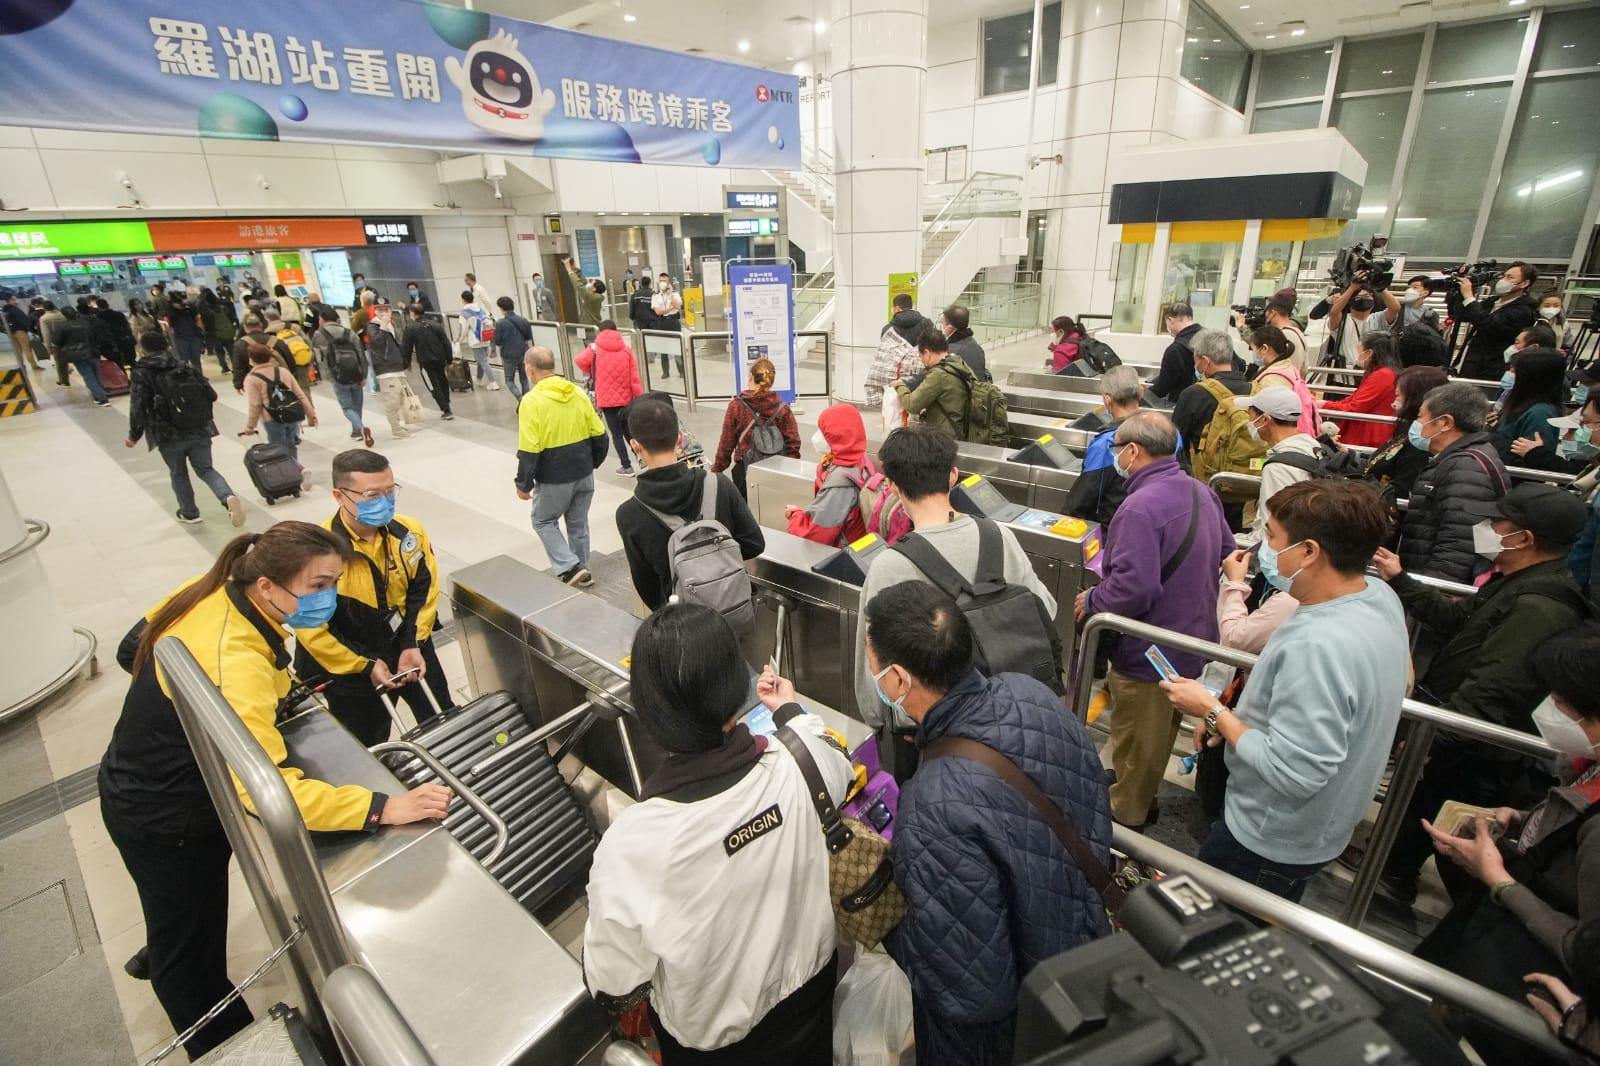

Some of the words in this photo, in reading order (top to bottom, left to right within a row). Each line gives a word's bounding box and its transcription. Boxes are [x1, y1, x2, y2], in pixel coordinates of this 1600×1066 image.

[149, 17, 442, 103] 羅湖站重開
[561, 78, 732, 134] 服務跨境乘客
[770, 88, 793, 104] MTR
[728, 810, 780, 848] ORIGIN
